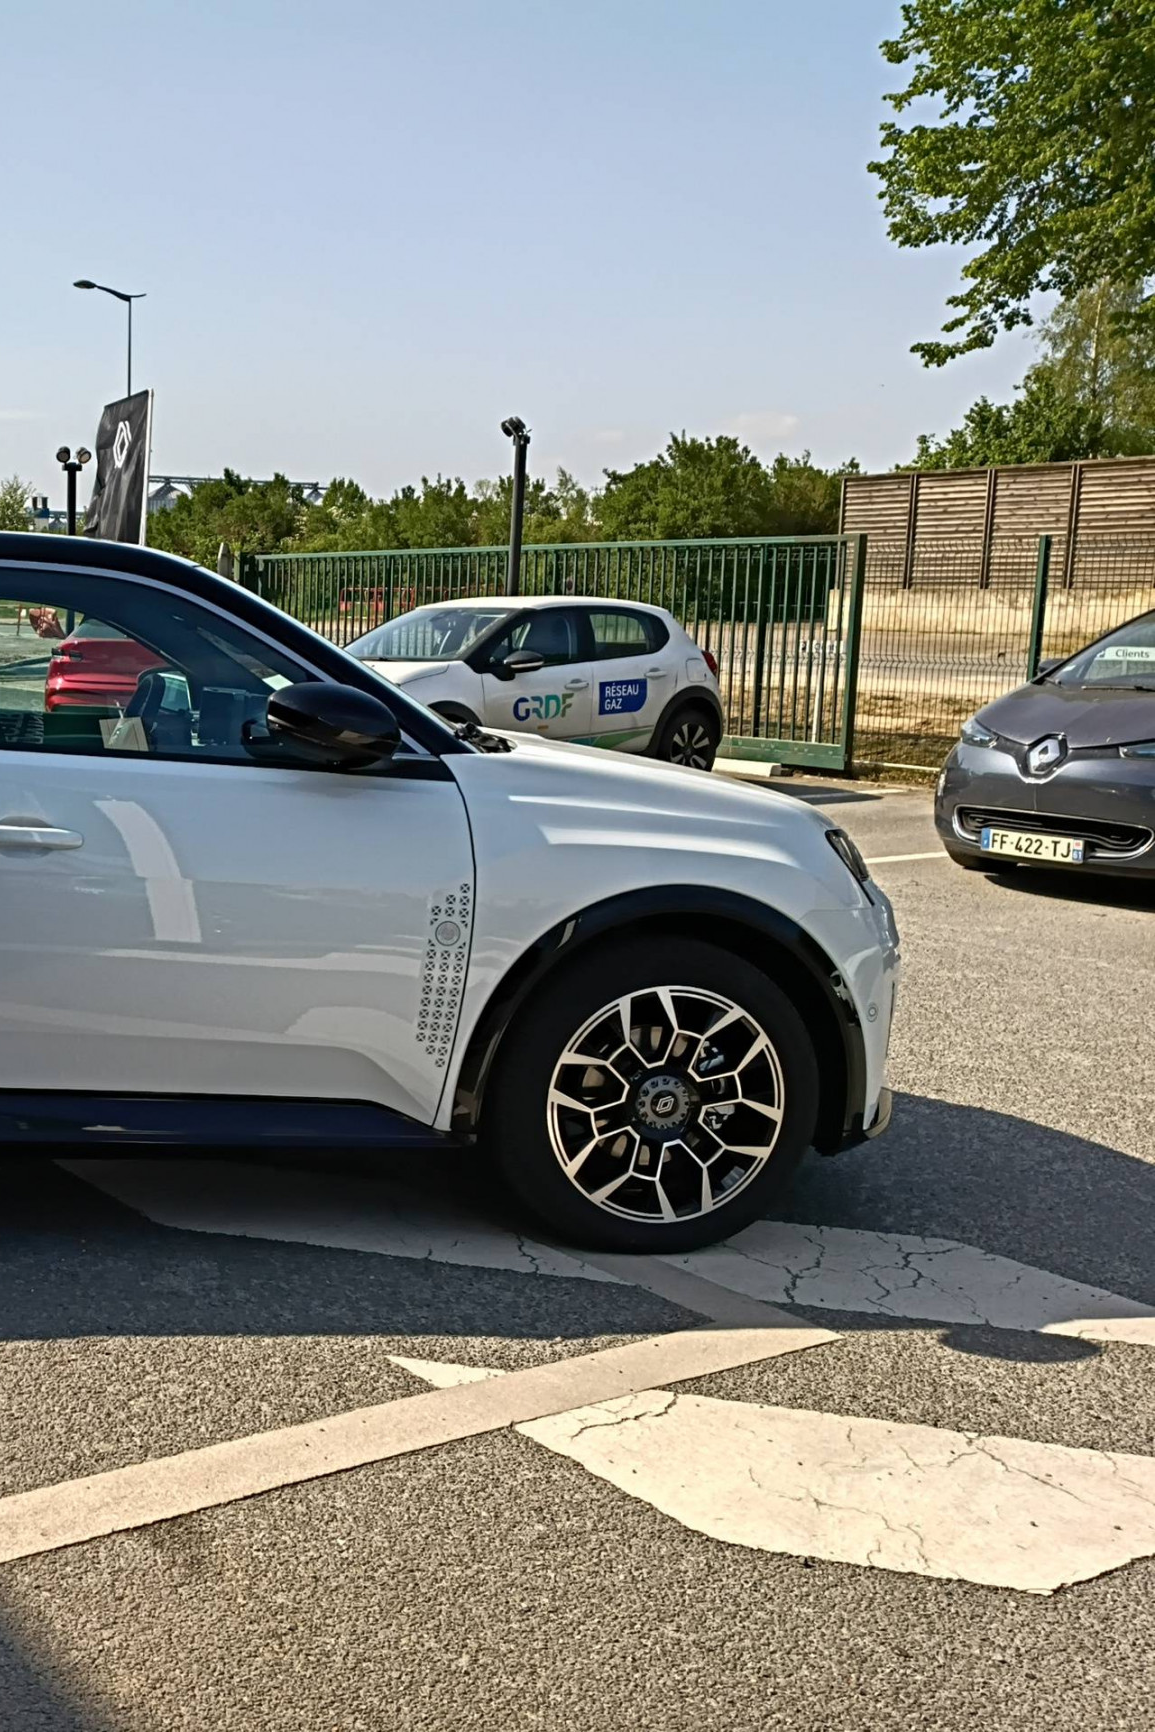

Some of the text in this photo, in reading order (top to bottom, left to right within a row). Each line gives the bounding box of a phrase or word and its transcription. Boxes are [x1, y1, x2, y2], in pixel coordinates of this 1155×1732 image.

[1115, 648, 1150, 659] Clients
[605, 682, 639, 698] RÉSEAU
[513, 692, 575, 721] GRDF
[604, 698, 622, 711] GAZ
[991, 832, 1071, 858] FF-422-TJ
